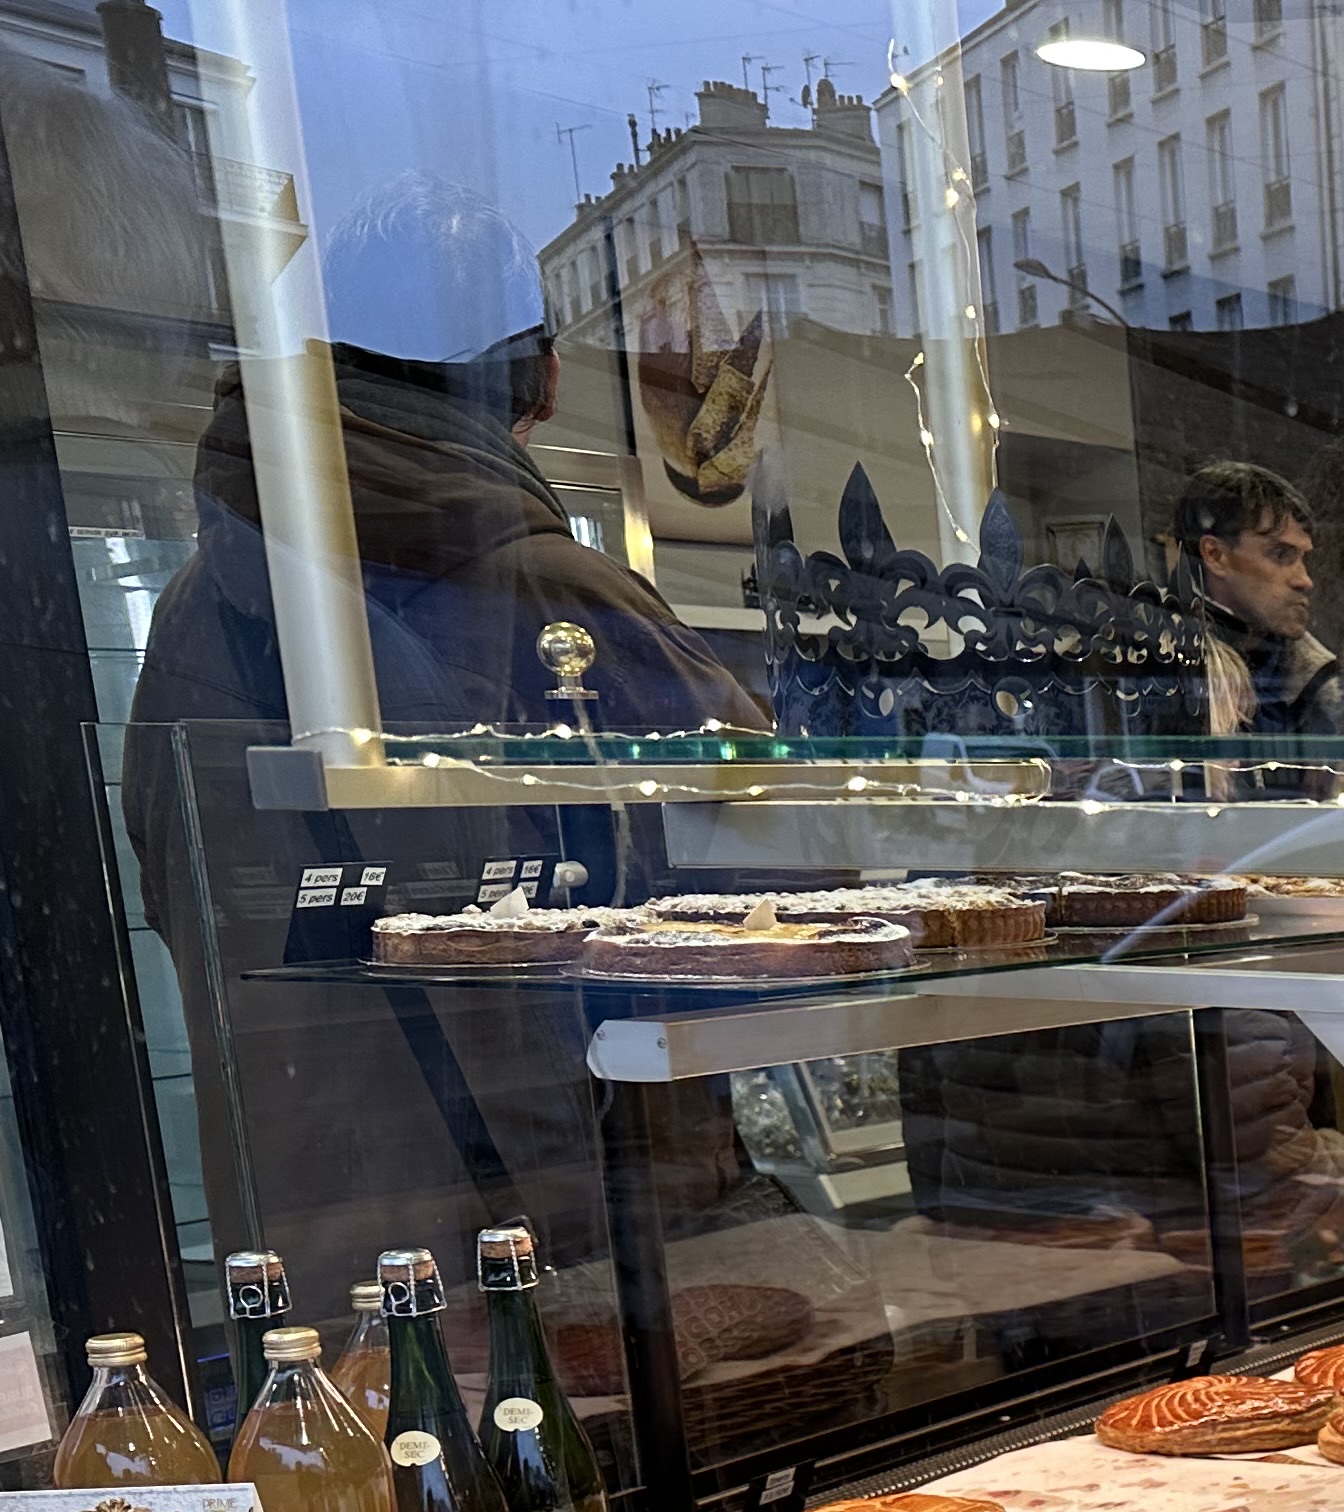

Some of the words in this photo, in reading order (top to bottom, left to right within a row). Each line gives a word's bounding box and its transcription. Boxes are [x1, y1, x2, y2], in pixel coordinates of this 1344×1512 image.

[364, 871, 384, 881] 16€
[486, 867, 492, 875] 4
[305, 873, 313, 882] 4
[314, 873, 338, 884] pers
[299, 893, 307, 903] 5
[308, 893, 333, 905] pers
[343, 891, 365, 902] 20€
[481, 889, 488, 899] 5
[508, 1416, 529, 1424] SEC
[404, 1450, 426, 1459] SEC
